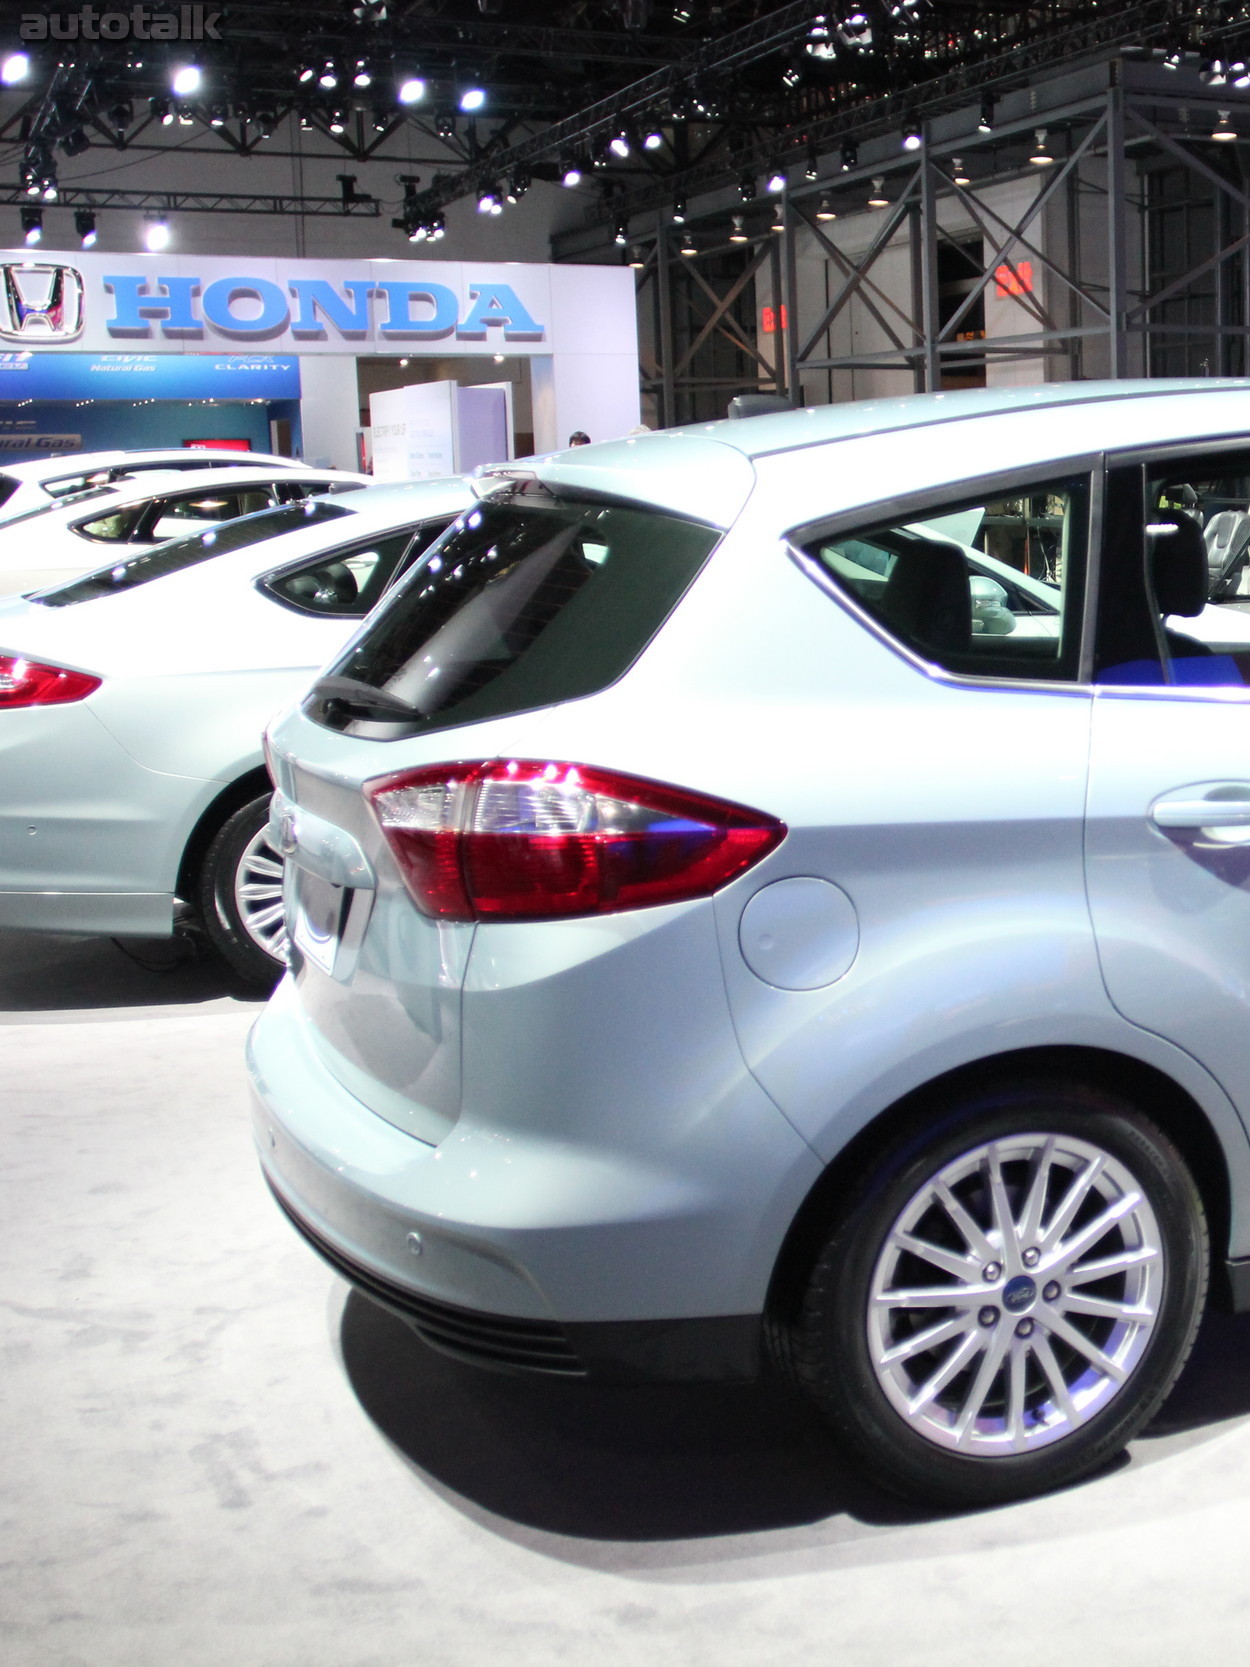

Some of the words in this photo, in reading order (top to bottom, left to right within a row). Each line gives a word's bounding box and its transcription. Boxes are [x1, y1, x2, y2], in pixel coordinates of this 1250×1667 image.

[103, 275, 546, 338] HONDA
[90, 364, 133, 373] Natural
[133, 364, 156, 372] Gas
[214, 363, 291, 371] CLARITY
[35, 437, 77, 449] Gas
